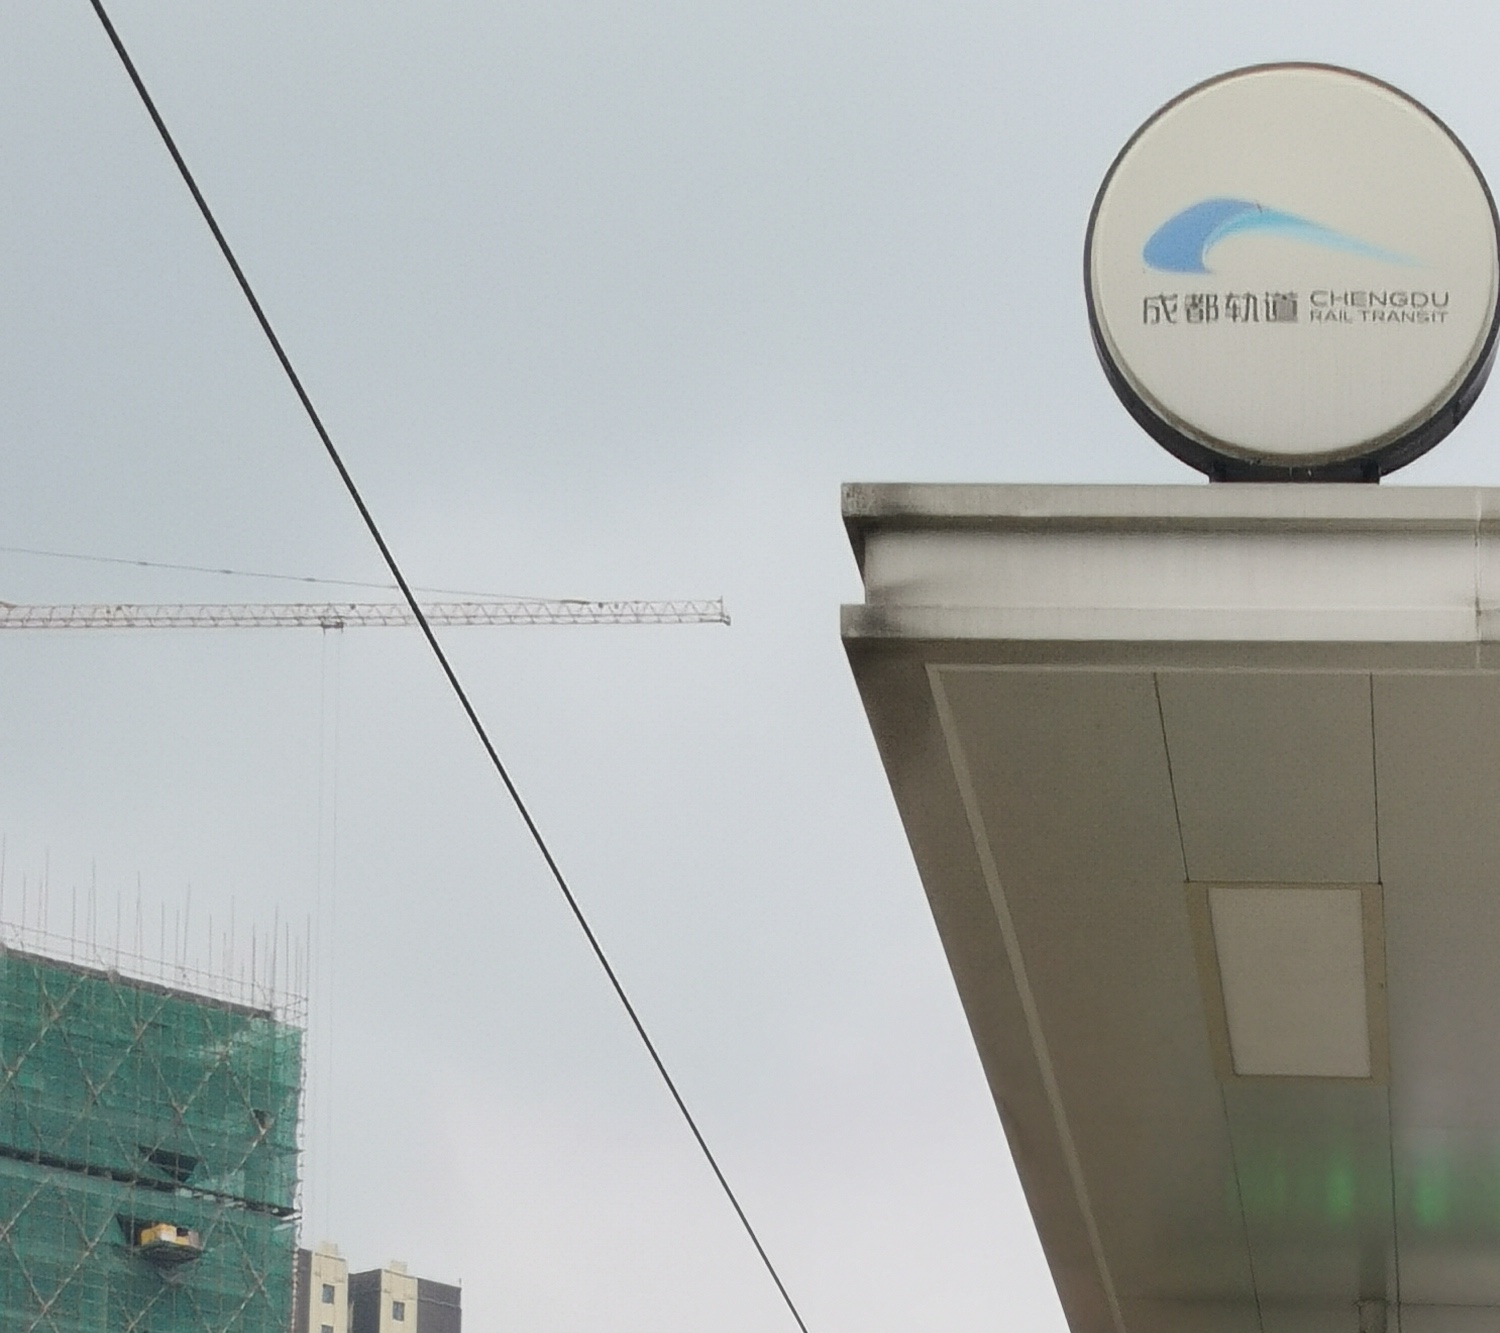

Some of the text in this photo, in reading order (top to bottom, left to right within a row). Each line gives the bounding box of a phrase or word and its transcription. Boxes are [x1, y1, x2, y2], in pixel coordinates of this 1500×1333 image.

[1310, 290, 1449, 307] CHENGDU
[1143, 291, 1298, 325] 成都轨道
[1310, 310, 1448, 323] RAIL TRANSIT
